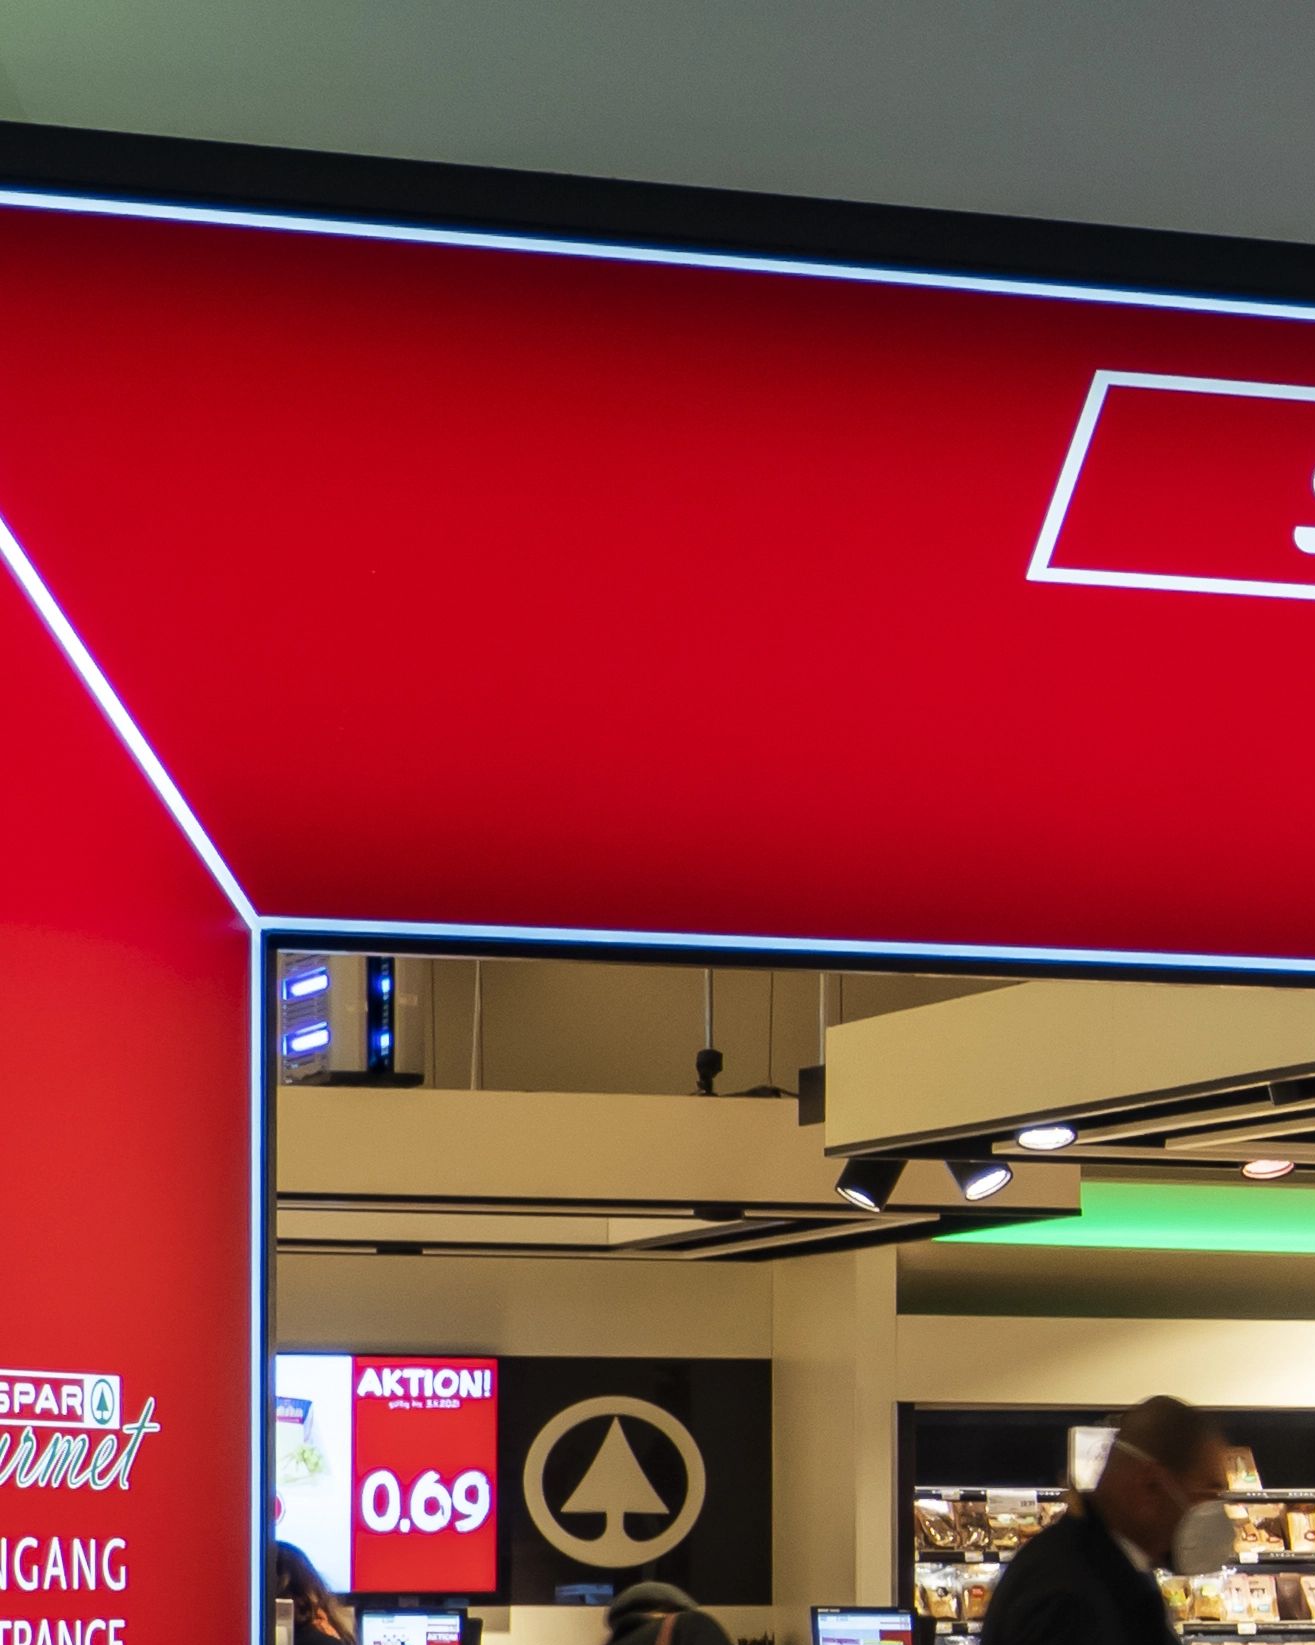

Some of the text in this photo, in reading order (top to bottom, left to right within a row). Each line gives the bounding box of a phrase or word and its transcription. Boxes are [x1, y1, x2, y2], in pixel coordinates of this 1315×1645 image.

[357, 1367, 491, 1397] AKTION!
[0, 1396, 160, 1491] rmet
[361, 1469, 491, 1533] 0.69
[0, 1537, 126, 1591] GANG
